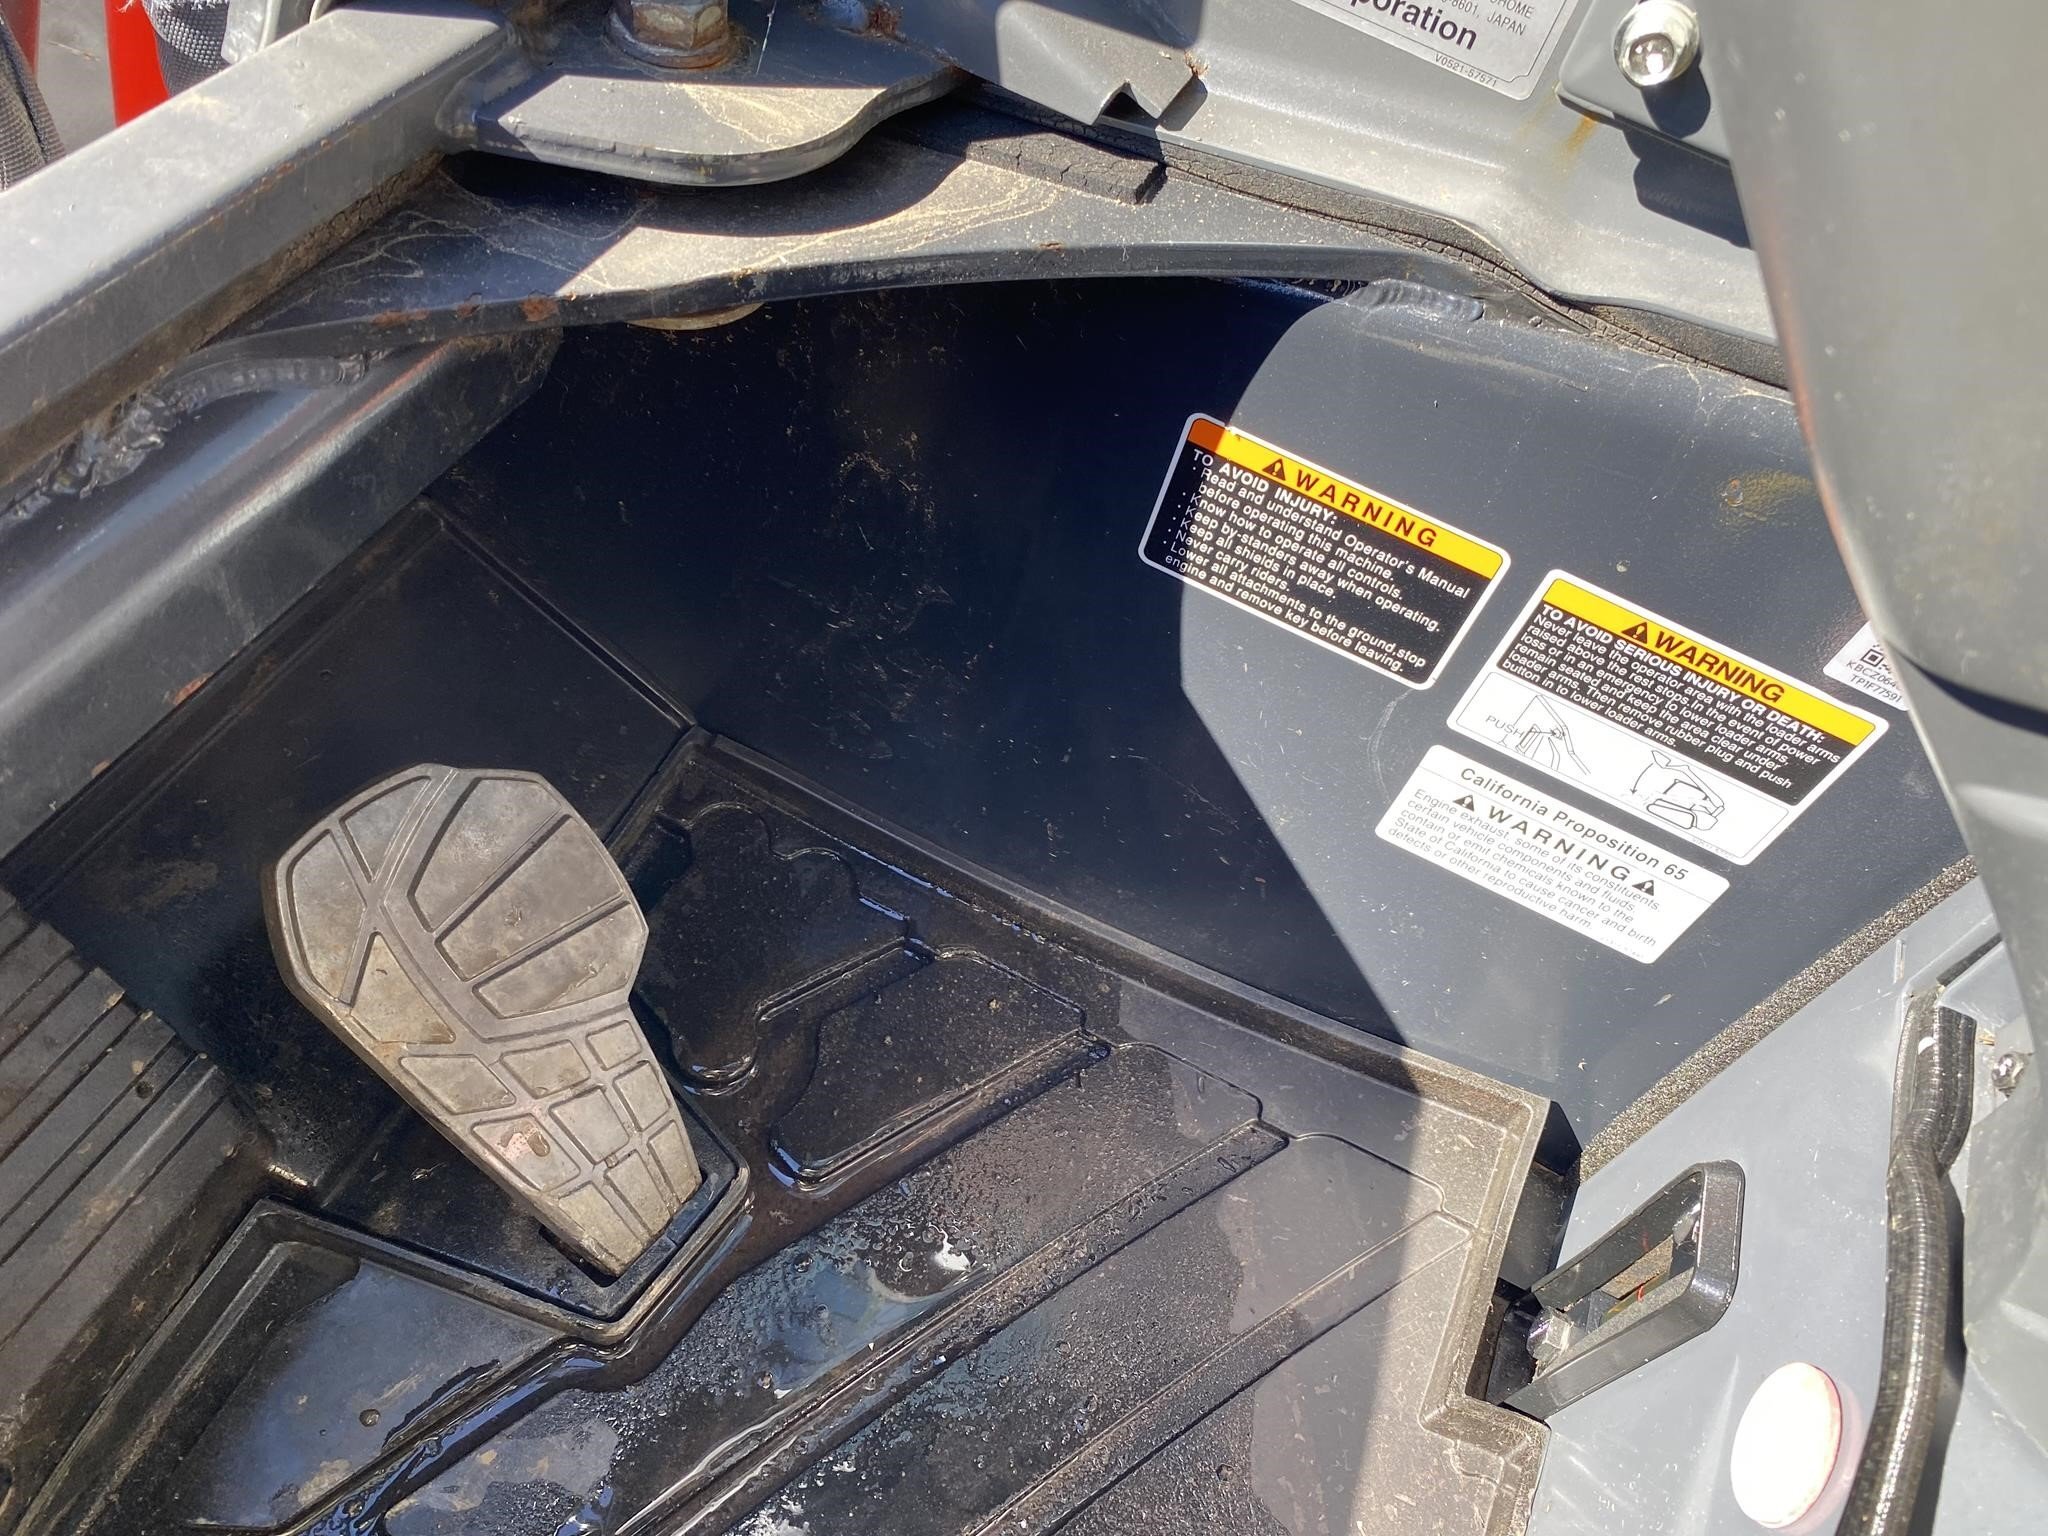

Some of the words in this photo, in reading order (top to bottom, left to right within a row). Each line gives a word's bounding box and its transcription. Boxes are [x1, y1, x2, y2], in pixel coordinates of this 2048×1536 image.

[1435, 53, 1498, 88] V0521-57571
[1487, 12, 1526, 36] JAPAN
[1193, 448, 1214, 467] TO
[1218, 462, 1269, 492] AVOID
[1274, 487, 1337, 525] INJURY:
[1198, 481, 1240, 509] before
[1242, 504, 1305, 542] operating
[1307, 532, 1332, 552] this
[1334, 547, 1394, 581] machine.
[1200, 467, 1237, 492] Read
[1237, 487, 1265, 505] and
[1266, 500, 1343, 541] understand
[1344, 534, 1415, 575] Operator's
[1417, 567, 1470, 599] Manual
[1296, 469, 1437, 547] WARNING
[1170, 540, 1210, 566] Lower
[1210, 562, 1228, 575] all
[1228, 570, 1306, 612] attachments
[1308, 606, 1322, 620] to
[1324, 613, 1346, 630] the
[1175, 529, 1214, 555] Never
[1215, 550, 1249, 573] carry
[1250, 566, 1290, 592] riders.
[1178, 517, 1213, 542] Keep
[1215, 536, 1233, 550] all
[1233, 545, 1280, 572] shields
[1282, 565, 1296, 579] in
[1296, 574, 1336, 599] place.
[1184, 505, 1218, 530] Keep
[1220, 521, 1297, 568] by-standers
[1299, 560, 1335, 584] away
[1337, 577, 1373, 600] when
[1374, 595, 1440, 632] operating.
[1190, 492, 1227, 518] Know
[1228, 510, 1257, 531] how
[1258, 525, 1272, 539] to
[1274, 534, 1325, 563] operate
[1327, 559, 1346, 573] all
[1346, 567, 1402, 600] controls.
[1165, 554, 1207, 580] engine
[1208, 575, 1235, 592] and
[1235, 587, 1283, 615] remove
[1284, 608, 1309, 628] key
[1310, 620, 1353, 647] before
[1354, 640, 1403, 672] leaving.
[1502, 658, 1540, 682] button
[1541, 676, 1554, 689] in
[1555, 683, 1569, 695] to
[1569, 690, 1605, 711] lower
[1604, 706, 1644, 730] loader
[1644, 727, 1676, 747] arms.
[1514, 642, 1557, 667] remain
[1557, 663, 1602, 687] seated
[1600, 683, 1628, 699] and
[1626, 693, 1658, 714] keep
[1658, 708, 1680, 724] the
[1680, 720, 1710, 739] area
[1710, 735, 1744, 753] clear
[1743, 750, 1782, 771] under
[1520, 632, 1547, 650] loss
[1548, 646, 1563, 657] or
[1563, 651, 1576, 664] in
[1576, 660, 1594, 673] an
[1595, 669, 1664, 705] emergency
[1664, 699, 1678, 711] to
[1678, 706, 1715, 728] lower
[1714, 722, 1756, 747] loader
[1754, 744, 1789, 766] arms,
[1526, 624, 1567, 647] raised
[1566, 643, 1605, 665] above
[1606, 660, 1628, 676] the
[1628, 672, 1655, 689] rest
[1705, 706, 1727, 722] the
[1727, 719, 1765, 740] event
[1764, 736, 1781, 746] of
[1776, 742, 1821, 765] power
[1533, 613, 1572, 637] Never
[1572, 631, 1607, 654] leave
[1608, 649, 1629, 665] the
[1630, 661, 1685, 689] operator
[1683, 686, 1714, 704] area
[1715, 700, 1742, 717] with
[1742, 712, 1765, 727] the
[1764, 722, 1808, 747] loader
[1806, 743, 1841, 763] arms
[1542, 603, 1563, 621] TO
[1563, 616, 1613, 644] AVOID
[1613, 639, 1683, 676] SERIOUS
[1682, 670, 1741, 702] INJURY
[1740, 698, 1767, 716] OR
[1765, 710, 1825, 743] DEATH:
[1654, 630, 1785, 703] WARNING
[1849, 674, 1902, 703] TP1F77591
[1485, 714, 1525, 738] PUSH
[1508, 650, 1548, 673] loader
[1547, 670, 1580, 691] arms.
[1586, 685, 1616, 706] Then
[1617, 702, 1664, 728] remove
[1664, 724, 1706, 747] rubber
[1703, 744, 1735, 763] plug
[1734, 758, 1762, 773] and
[1757, 769, 1792, 789] push
[1388, 828, 1431, 852] defects
[1433, 849, 1447, 858] or
[1449, 856, 1481, 875] other
[1482, 872, 1557, 912] reproductive
[1400, 809, 1445, 834] contain
[1447, 831, 1461, 841] or
[1463, 839, 1491, 855] emit
[1492, 852, 1554, 885] chemicals
[1555, 880, 1596, 905] known
[1597, 901, 1611, 912] to
[1613, 908, 1634, 923] the
[1407, 800, 1450, 824] certain
[1453, 821, 1495, 845] vehicle
[1497, 842, 1573, 882] components
[1574, 879, 1601, 894] and
[1413, 788, 1458, 815] Engine
[1514, 838, 1550, 858] some
[1551, 855, 1567, 865] of
[1566, 862, 1583, 873] its
[1460, 768, 1548, 816] California
[1552, 810, 1659, 868] Proposition
[1663, 863, 1689, 880] 65
[1488, 805, 1630, 881] WARNING
[1394, 816, 1426, 838] State
[1428, 835, 1443, 844] of
[1443, 840, 1502, 873] California
[1503, 869, 1516, 880] to
[1518, 877, 1556, 898] cause
[1557, 896, 1600, 919] cancer
[1601, 918, 1627, 932] and
[1627, 927, 1656, 946] birth
